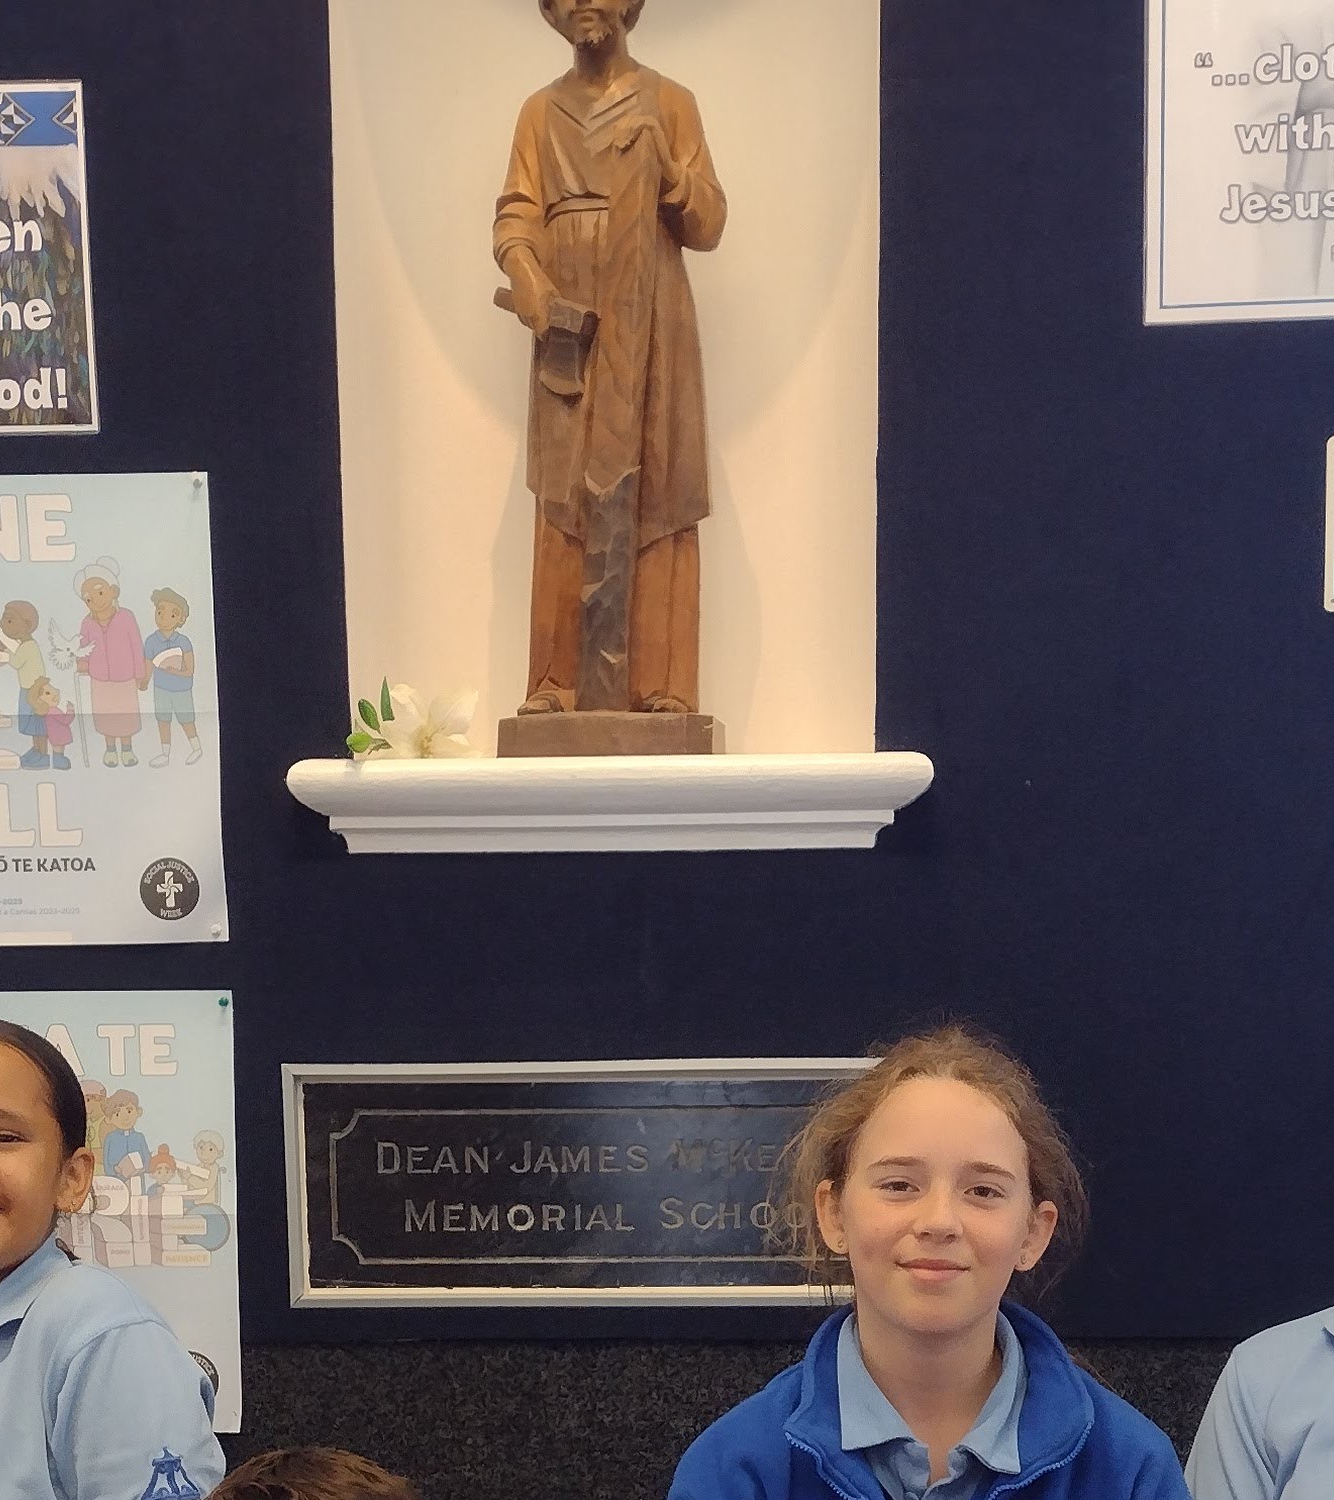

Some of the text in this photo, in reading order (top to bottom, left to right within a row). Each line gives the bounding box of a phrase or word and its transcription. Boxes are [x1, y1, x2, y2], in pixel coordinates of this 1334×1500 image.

[12, 858, 34, 873] TE
[37, 857, 97, 872] KATOA
[96, 1022, 179, 1077] TE
[376, 1140, 492, 1175] DEAN
[509, 1140, 650, 1175] JAMES
[404, 1196, 808, 1233] MEMORIAL SCHOO
